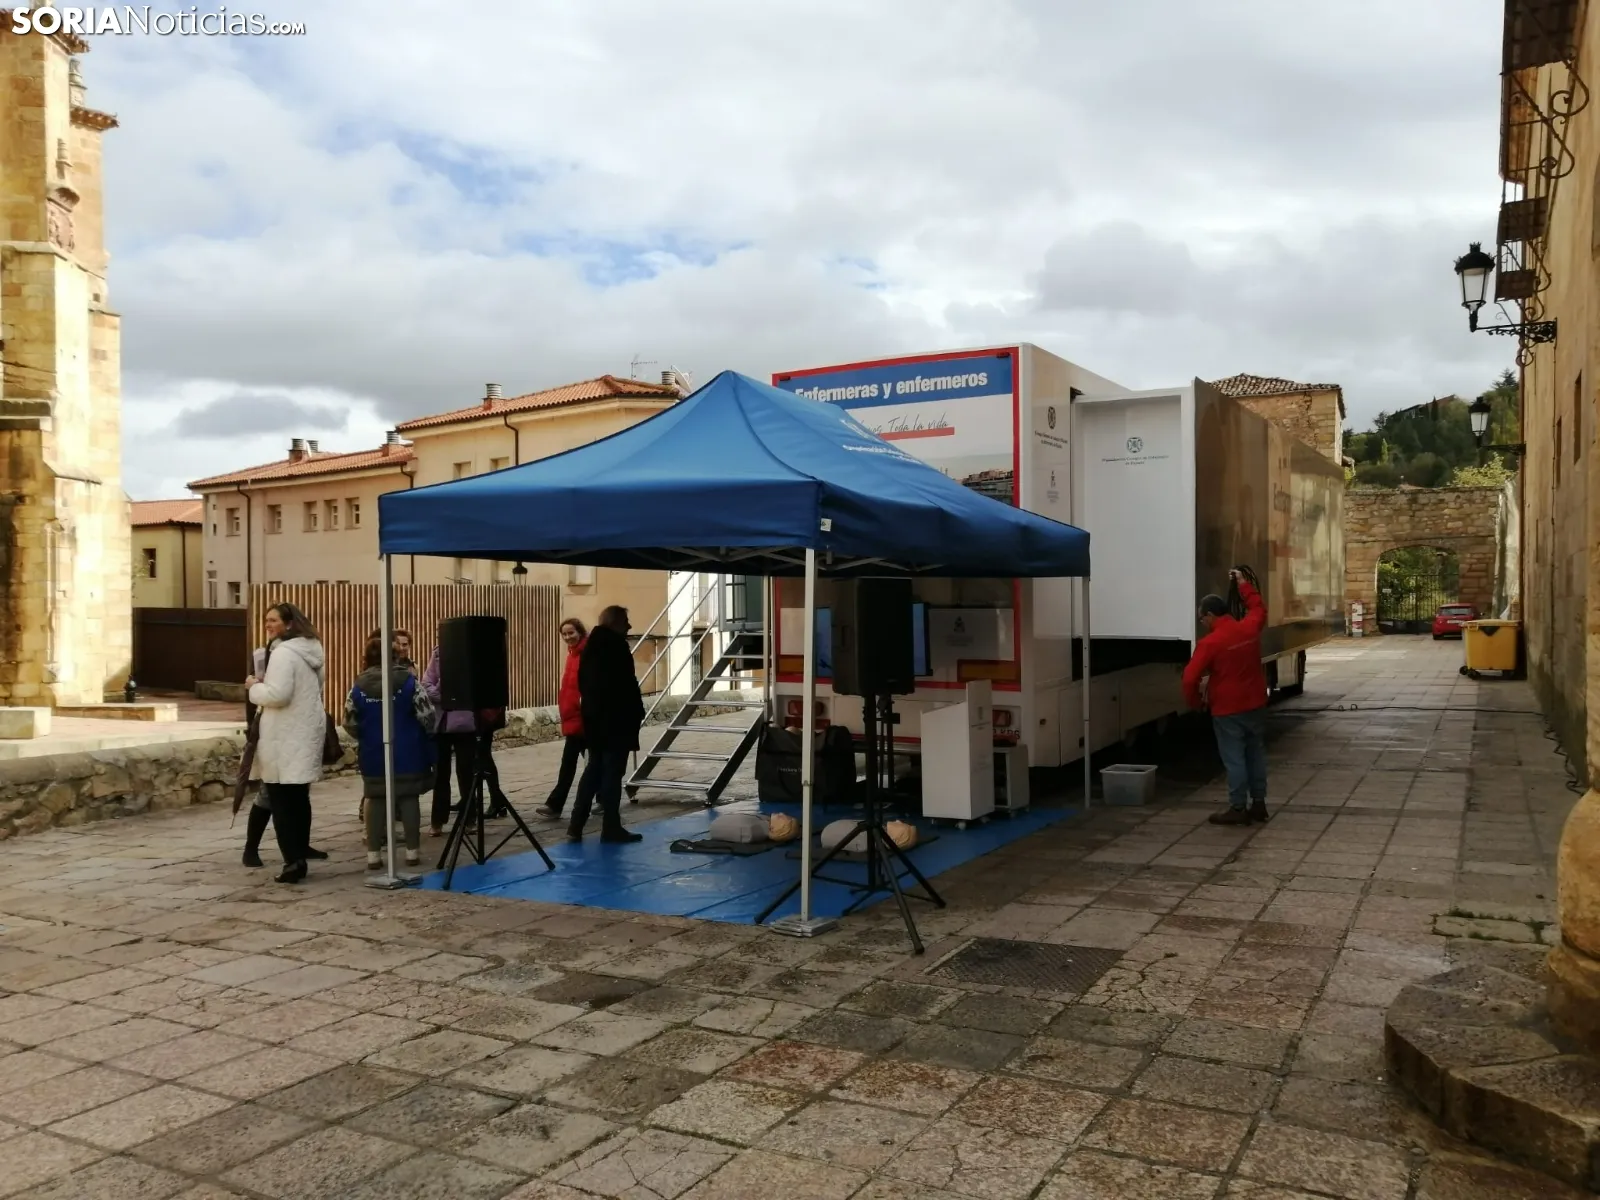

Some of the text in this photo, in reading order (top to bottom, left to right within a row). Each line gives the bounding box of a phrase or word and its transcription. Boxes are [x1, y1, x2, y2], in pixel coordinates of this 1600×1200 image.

[795, 372, 988, 402] Enfermeras y enfermeros
[888, 412, 910, 432] Toda
[928, 411, 949, 430] vida
